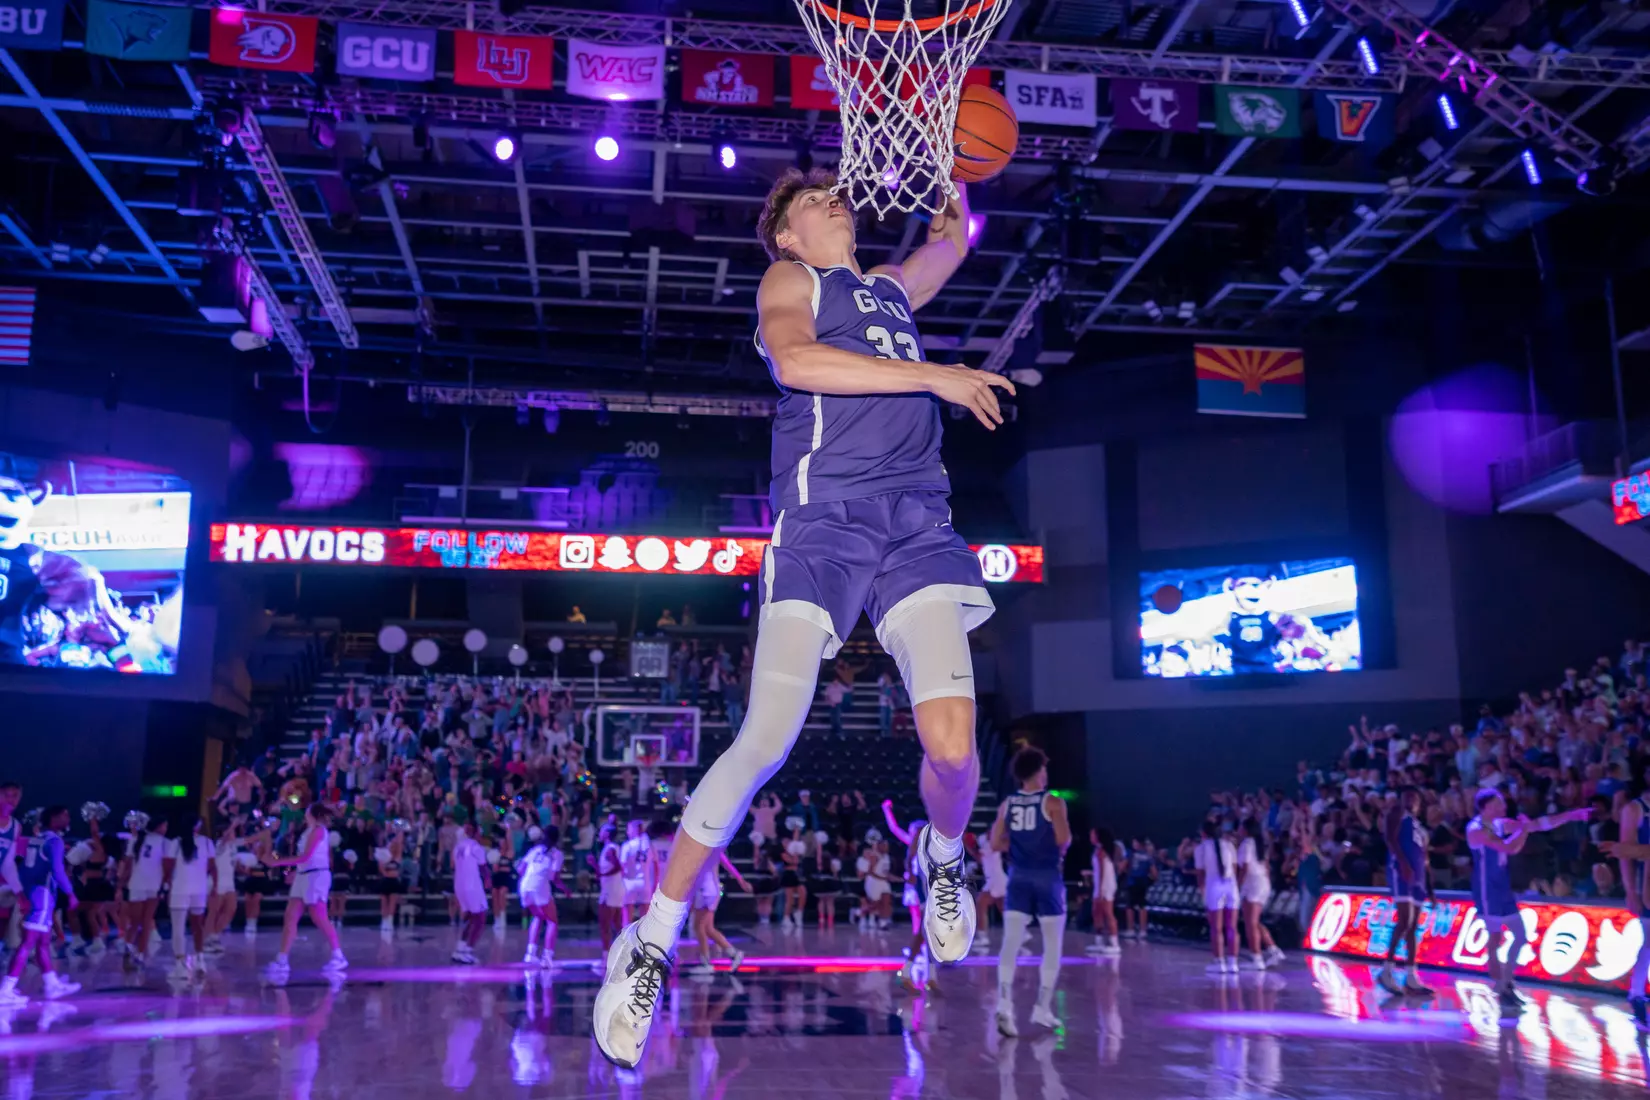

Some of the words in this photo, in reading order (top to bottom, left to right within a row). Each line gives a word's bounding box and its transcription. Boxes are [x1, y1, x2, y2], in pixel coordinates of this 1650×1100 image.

[343, 36, 430, 73] GCU
[477, 37, 531, 84] LU
[576, 52, 657, 83] WAC
[1017, 84, 1067, 109] SFA
[1326, 94, 1382, 141] V
[865, 325, 922, 362] 33
[624, 440, 660, 459] 200
[221, 524, 386, 562] HAVOCS
[413, 530, 529, 555] FOLLOW
[1010, 806, 1037, 831] 30
[1352, 897, 1461, 938] FOLOW
